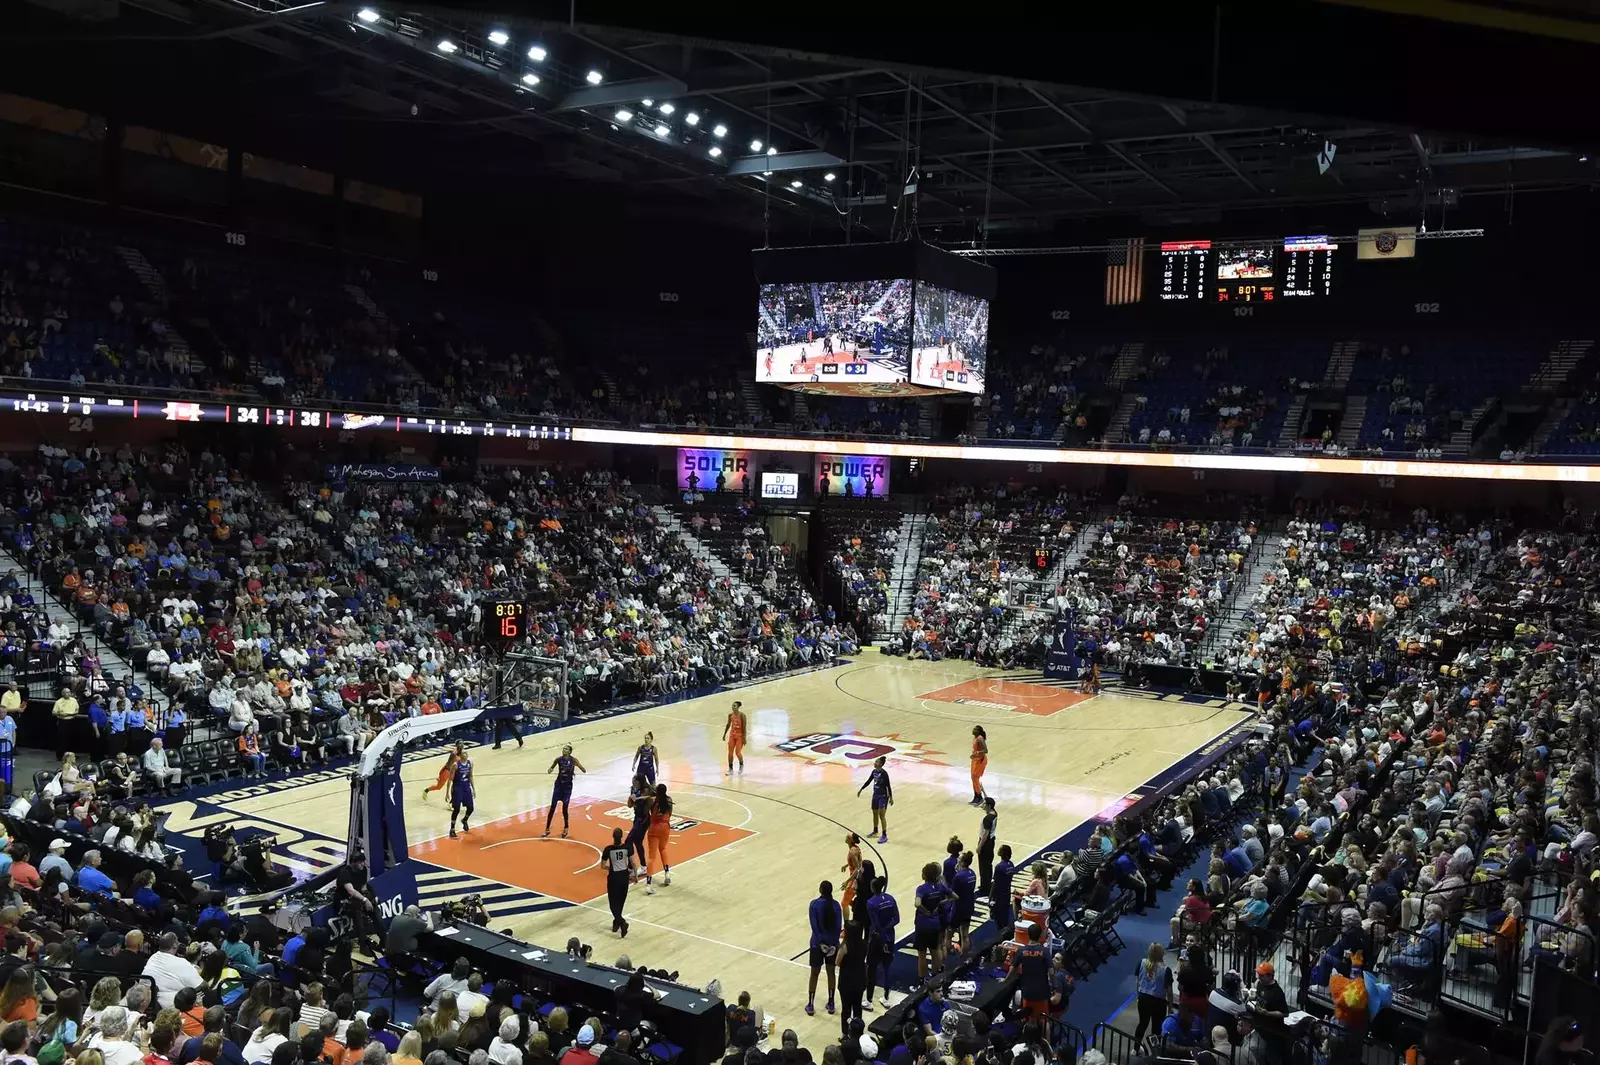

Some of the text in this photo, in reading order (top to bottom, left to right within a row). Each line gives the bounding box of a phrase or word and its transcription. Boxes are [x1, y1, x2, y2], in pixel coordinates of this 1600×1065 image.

[225, 232, 246, 246] 118
[1238, 286, 1256, 294] 8:07
[659, 292, 679, 302] 120
[1218, 293, 1229, 301] 34
[1264, 292, 1274, 300] 36
[1234, 306, 1254, 317] 101
[1414, 302, 1440, 313] 102
[1051, 310, 1070, 320] 122
[855, 364, 865, 373] 34
[13, 400, 91, 414] 14-42 7 0
[238, 408, 259, 423] 34
[276, 416, 284, 425] 3
[301, 412, 320, 427] 36
[69, 417, 94, 432] 24
[527, 440, 540, 451] 26
[684, 455, 748, 473] SOLAR
[341, 465, 439, 480] Mohegan Sun Arena
[820, 462, 884, 479] POWER
[1191, 469, 1205, 480] 11
[776, 475, 785, 484] DJ
[1378, 477, 1395, 488] 12
[766, 485, 794, 494] ATLAS
[496, 604, 522, 616] 8:07
[501, 617, 517, 637] 16
[1056, 664, 1071, 672] AT&T
[387, 720, 412, 738] SPALDING
[779, 734, 832, 749] SUN
[615, 850, 624, 861] 19
